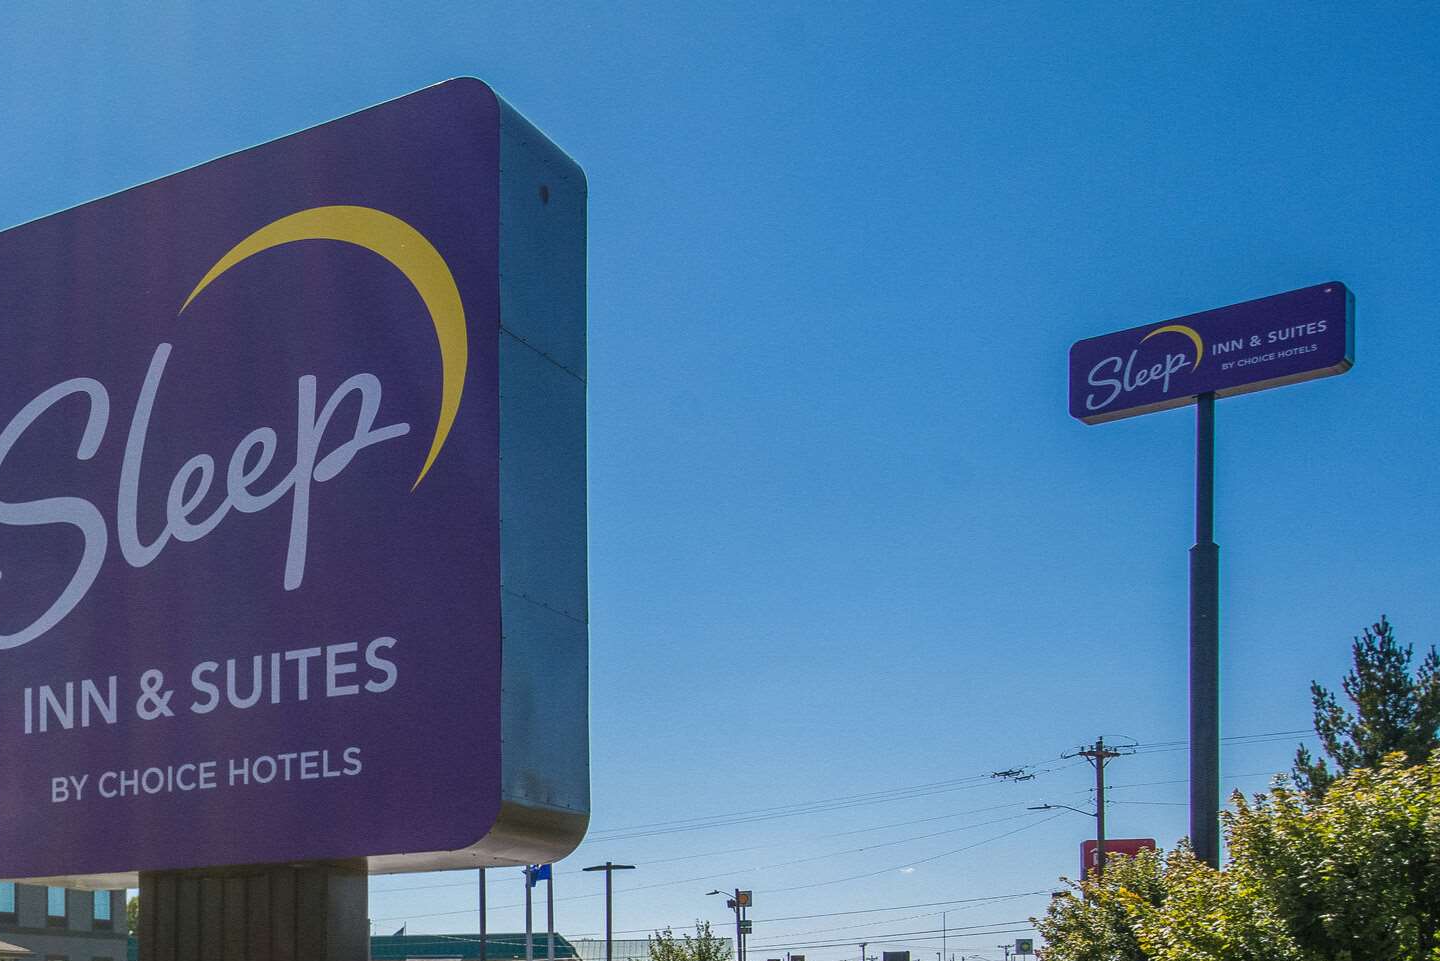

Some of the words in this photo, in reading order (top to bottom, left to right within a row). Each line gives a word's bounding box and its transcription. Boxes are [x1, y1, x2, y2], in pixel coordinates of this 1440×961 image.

[1212, 338, 1244, 356] INN
[1249, 335, 1262, 347] &
[1268, 320, 1328, 344] SUITES
[1221, 360, 1235, 370] BY
[1237, 353, 1276, 368] CHOICE
[1277, 344, 1318, 359] HOTELS
[1086, 349, 1191, 411] Sleep
[23, 677, 119, 734] INN
[136, 668, 175, 720] &
[189, 636, 398, 715] SUITES
[51, 773, 86, 803] BY
[98, 762, 217, 799] CHOICE
[227, 746, 363, 787] HOTELS
